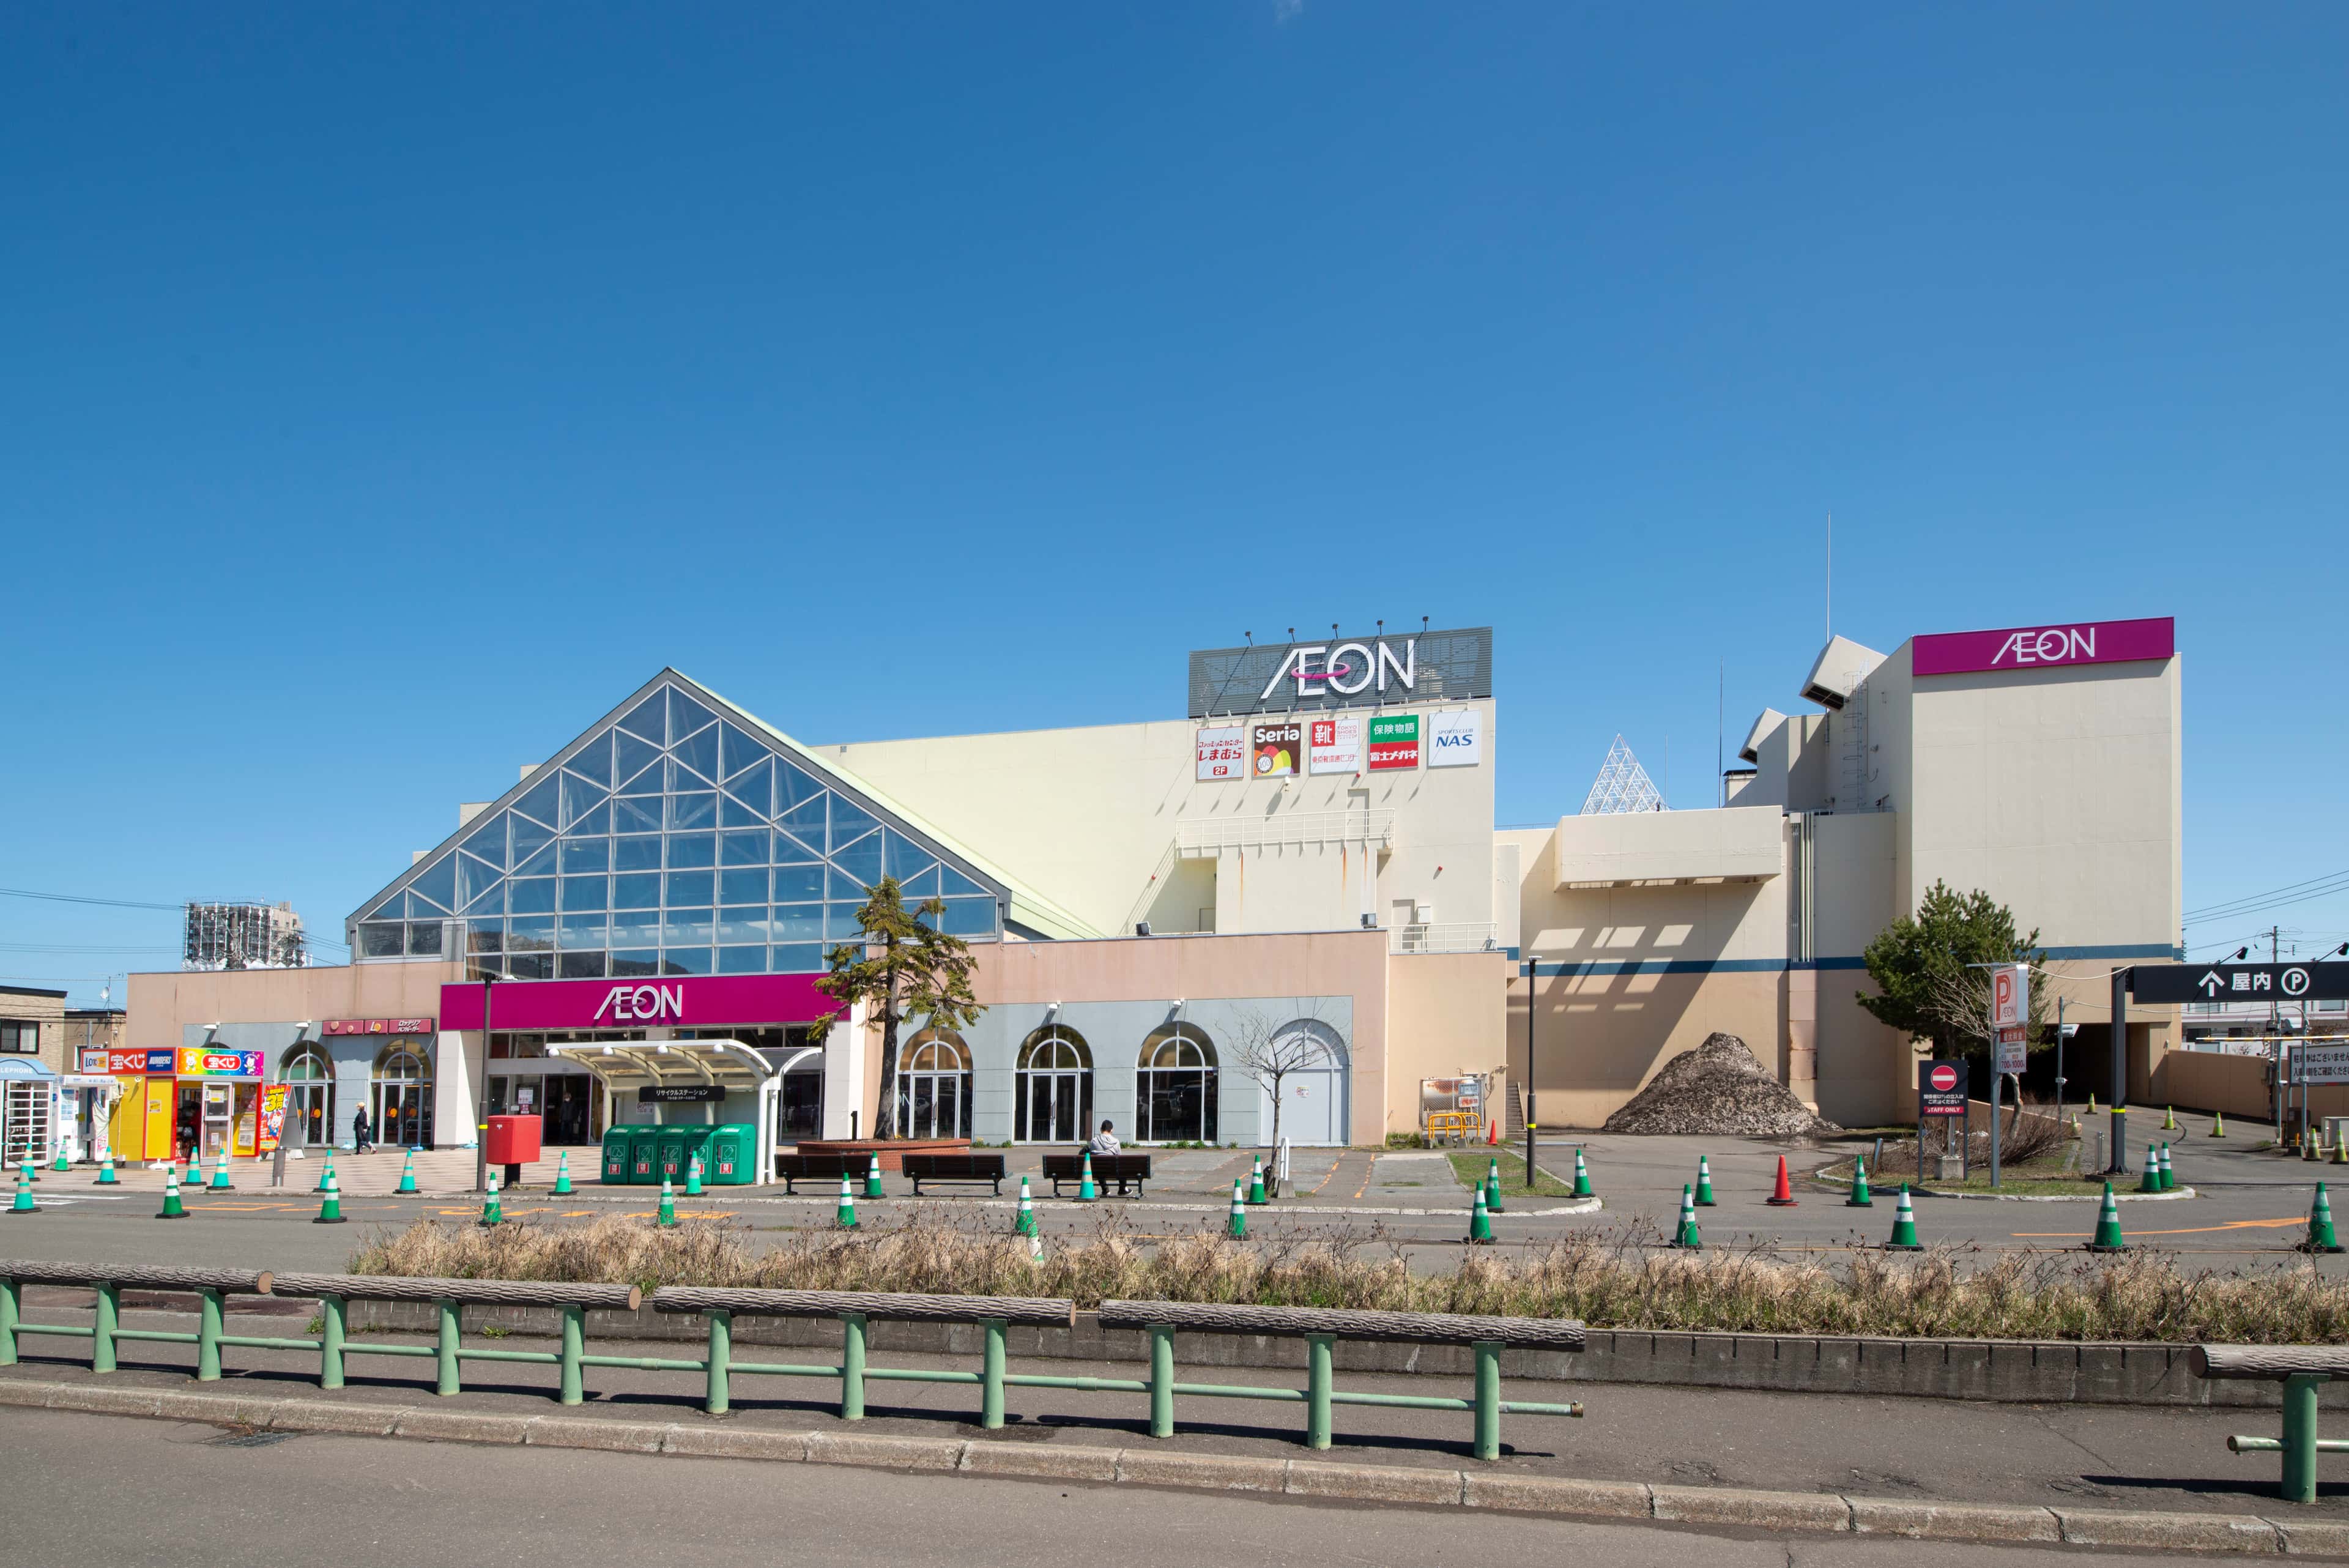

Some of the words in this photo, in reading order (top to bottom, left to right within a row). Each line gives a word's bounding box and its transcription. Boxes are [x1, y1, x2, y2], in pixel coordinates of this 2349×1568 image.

[1991, 628, 2095, 664] AEON
[1261, 640, 1414, 699] AEON
[1256, 726, 1299, 743] Seria
[1315, 724, 1332, 743] 靴
[1373, 723, 1415, 735] 保険物語
[1436, 734, 1472, 748] NAS
[1198, 748, 1243, 761] しまむら
[1370, 750, 1418, 762] 富士メガネ
[2232, 973, 2271, 990] 屋内
[593, 984, 683, 1019] AEON
[111, 1053, 145, 1069] 宝くじ
[208, 1057, 235, 1068] 宝くじ
